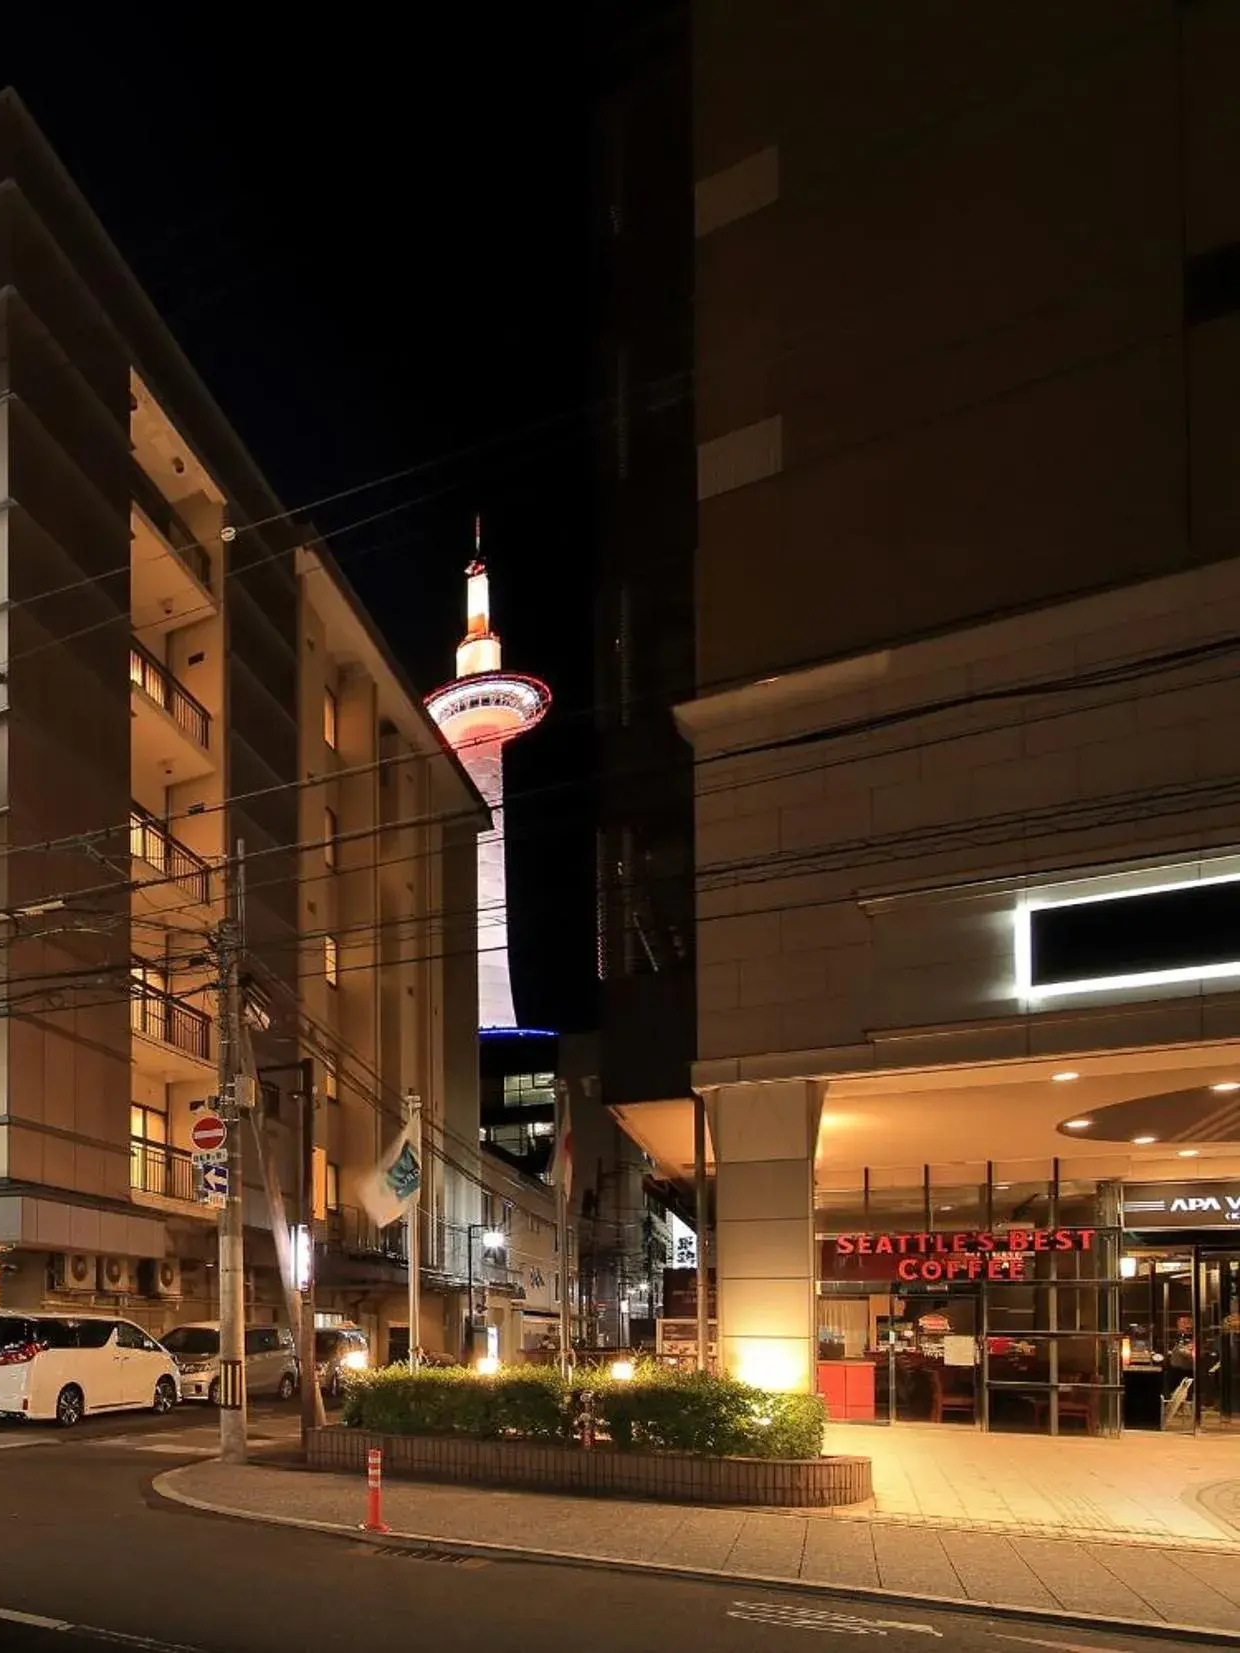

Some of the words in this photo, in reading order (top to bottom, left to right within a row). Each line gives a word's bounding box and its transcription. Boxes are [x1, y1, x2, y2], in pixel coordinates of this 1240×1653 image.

[1170, 1197, 1222, 1212] APA
[835, 1231, 995, 1255] SEATTLE'S
[1008, 1228, 1096, 1252] BEST
[897, 1258, 1026, 1281] COFFEE
